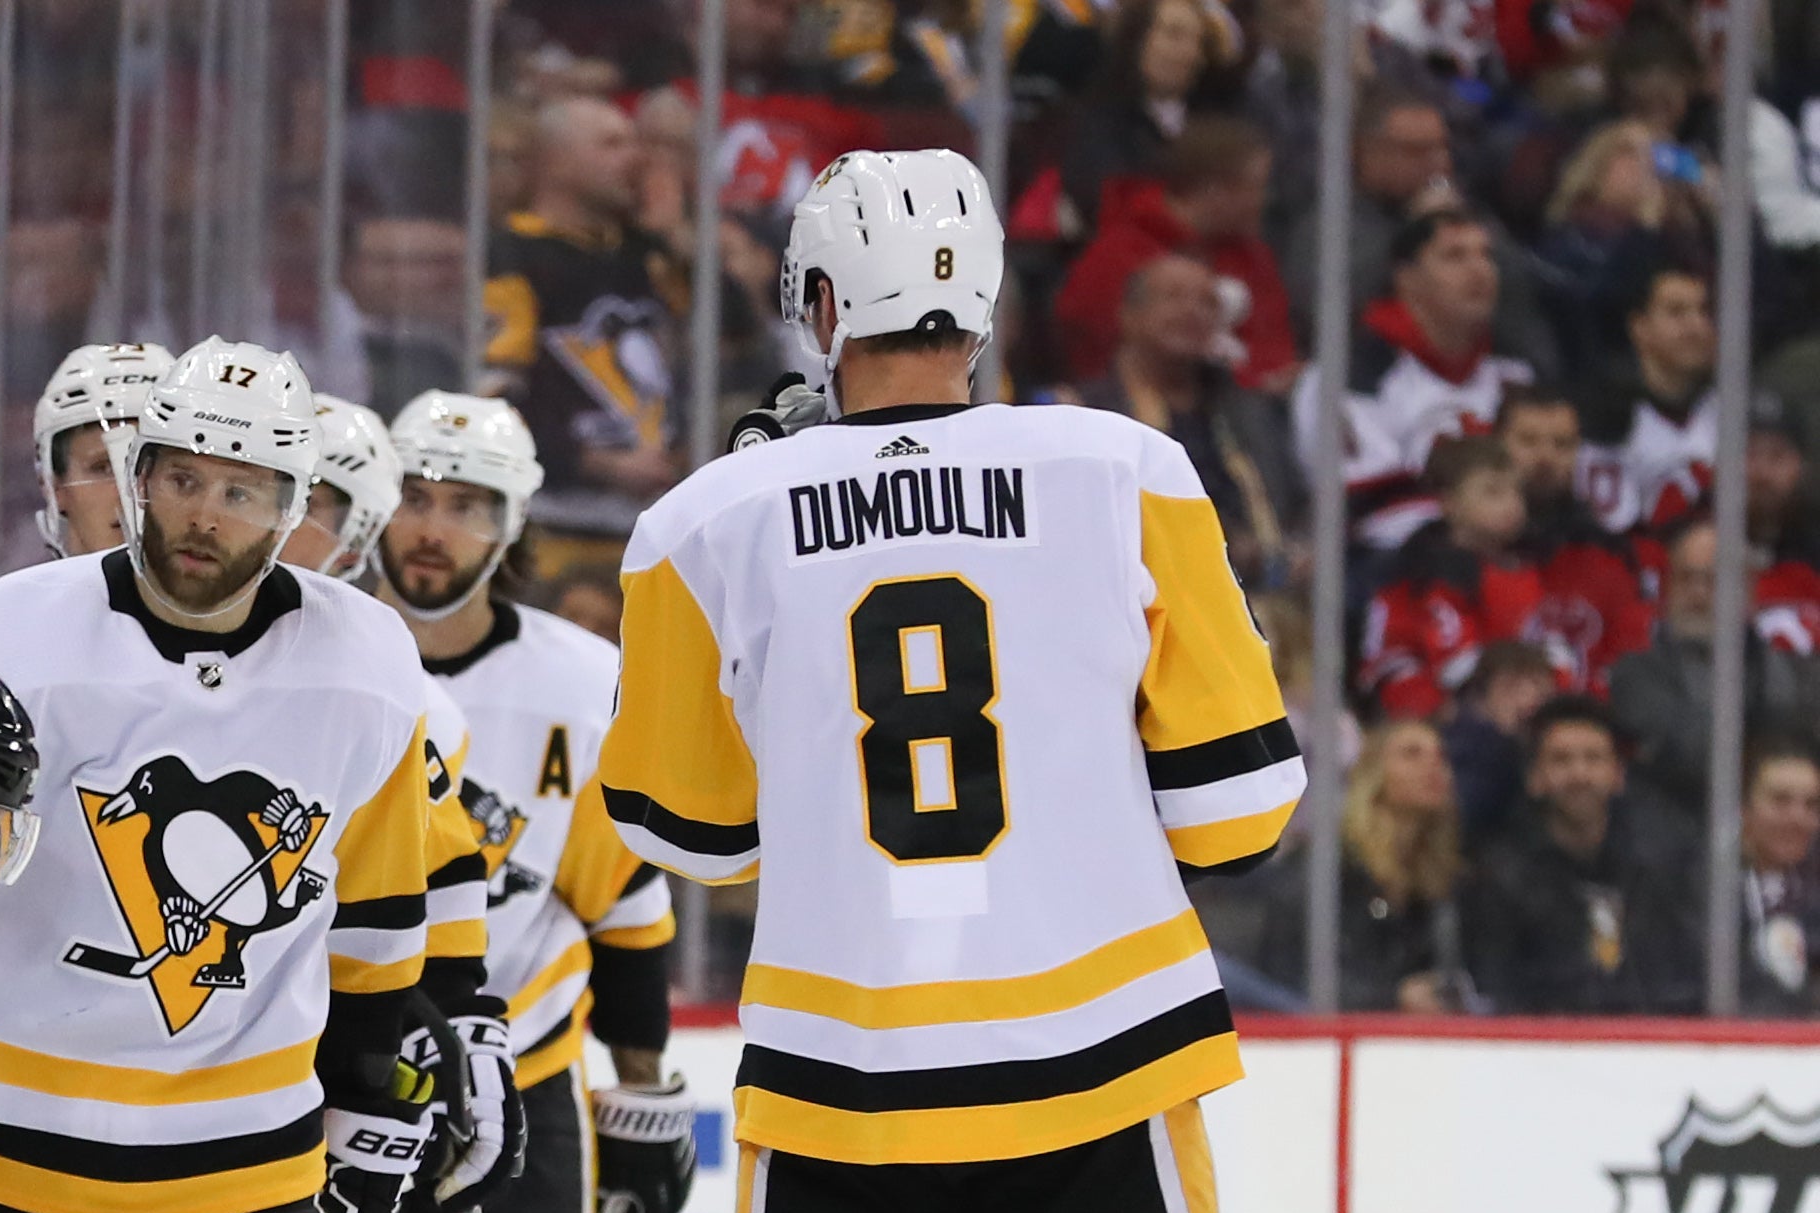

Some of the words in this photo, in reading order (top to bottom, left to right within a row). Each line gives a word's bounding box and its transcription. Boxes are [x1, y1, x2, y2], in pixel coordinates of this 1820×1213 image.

[934, 247, 954, 281] 8
[103, 374, 159, 386] CCM
[218, 364, 257, 388] 17
[874, 445, 930, 459] adidas
[788, 466, 1026, 556] DUMOULIN
[845, 571, 1012, 867] 8
[535, 724, 572, 799] A
